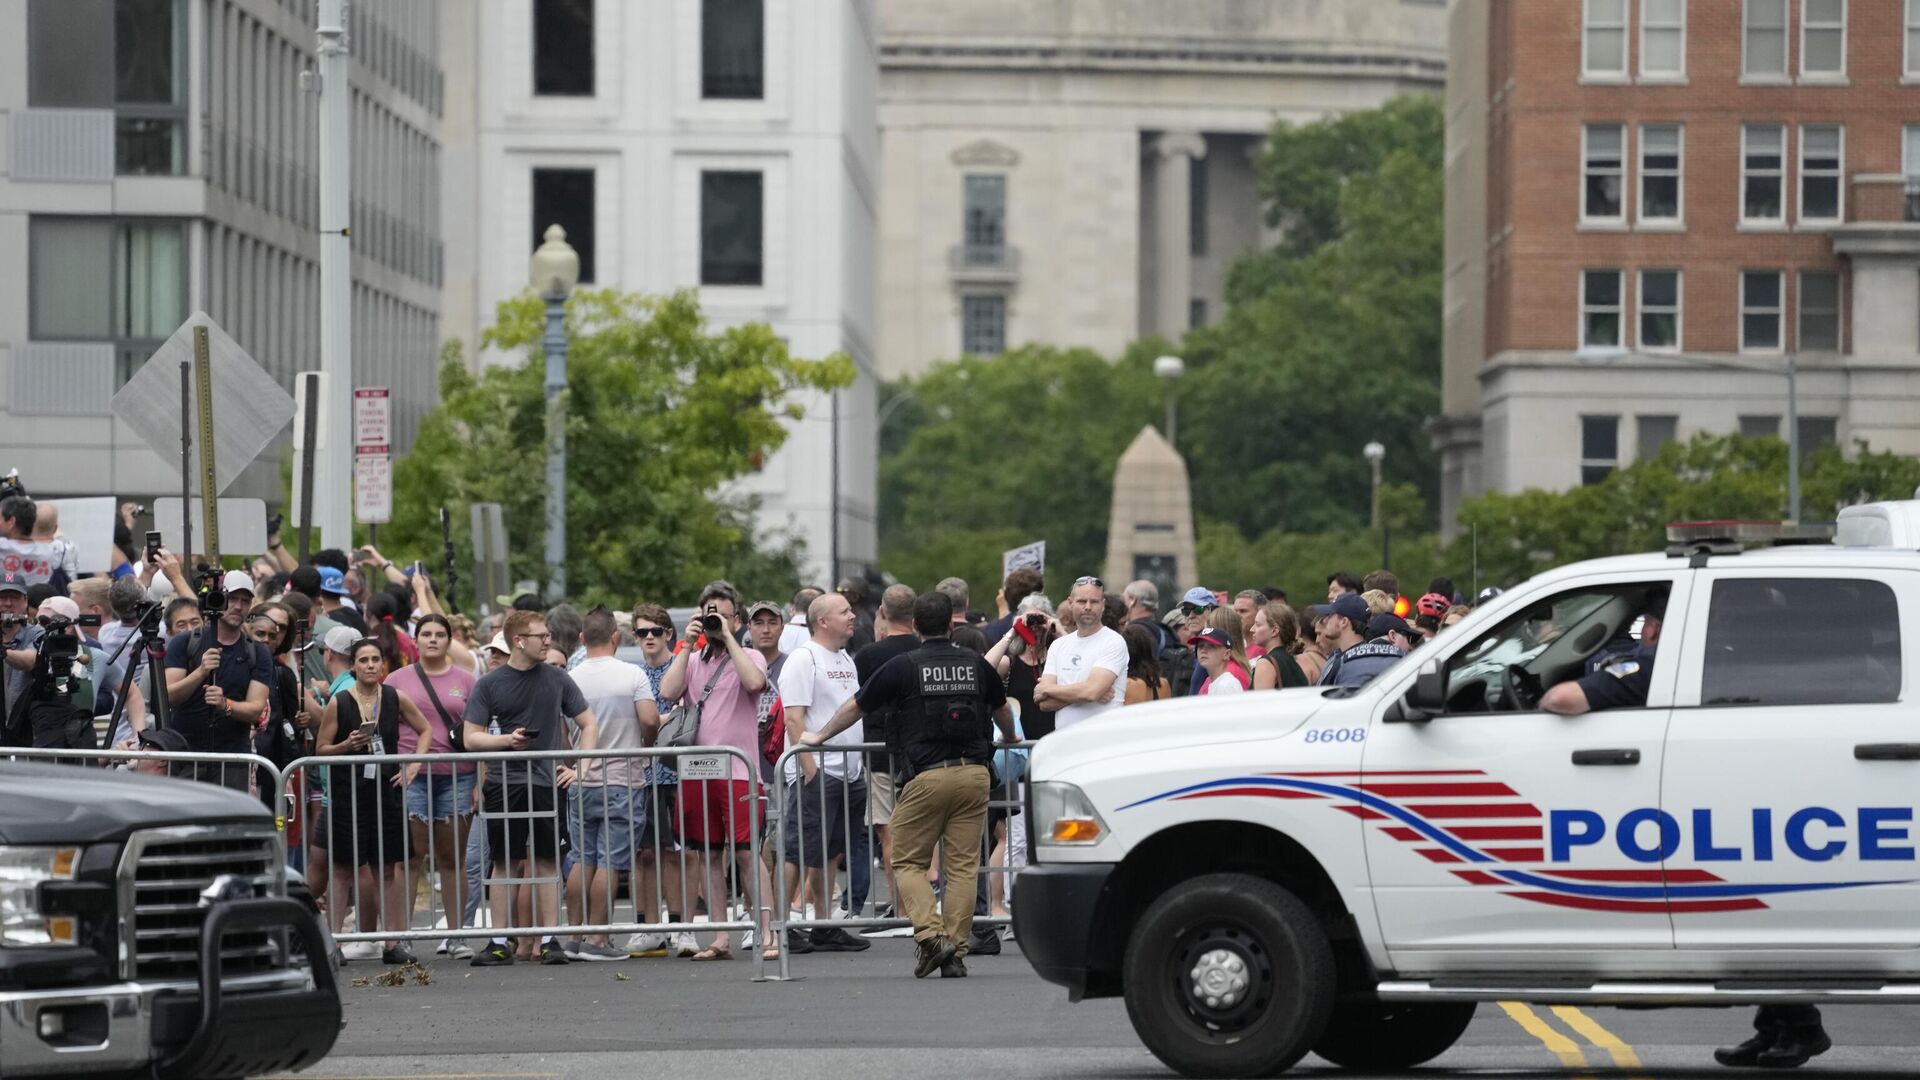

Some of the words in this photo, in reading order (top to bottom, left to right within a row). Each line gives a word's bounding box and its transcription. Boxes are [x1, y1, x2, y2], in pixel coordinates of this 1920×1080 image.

[1346, 648, 1398, 659] POLICE
[922, 666, 975, 682] POLICE
[924, 684, 948, 692] SECRET
[950, 683, 976, 691] SERVICE
[1304, 727, 1366, 743] 8608
[1549, 806, 1916, 863] POLICE
